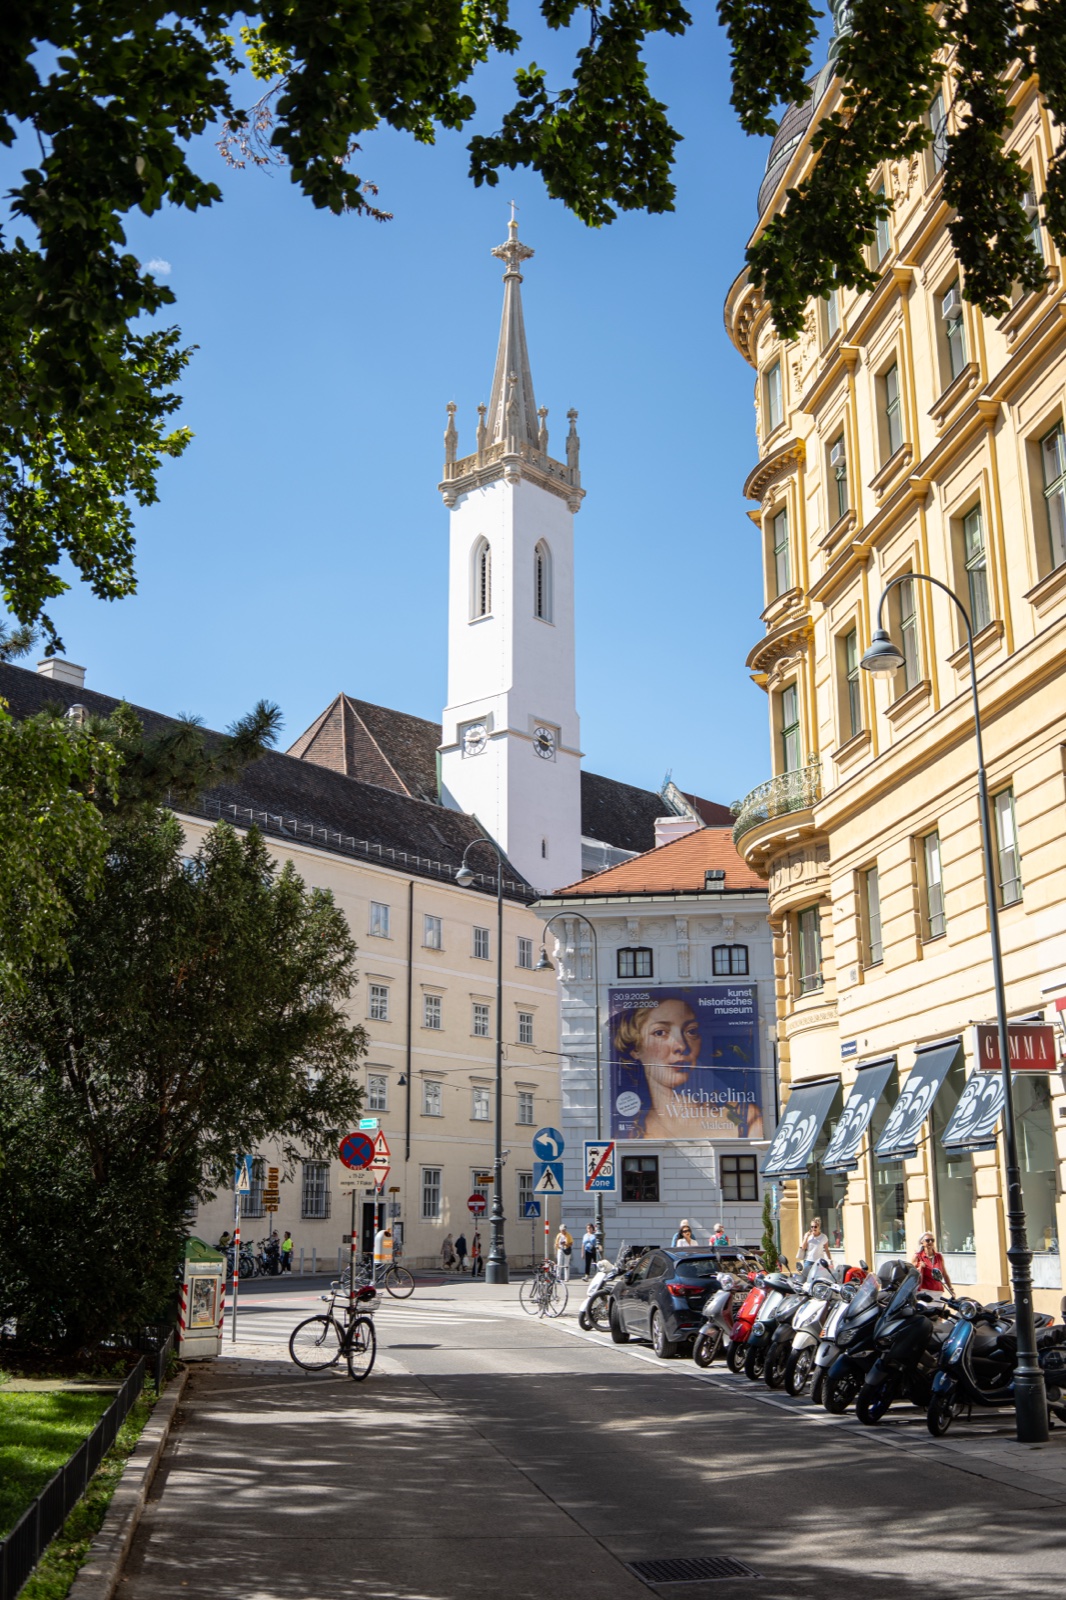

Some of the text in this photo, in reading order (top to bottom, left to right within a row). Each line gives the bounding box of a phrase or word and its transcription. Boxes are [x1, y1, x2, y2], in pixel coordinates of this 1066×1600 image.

[613, 993, 650, 1001] 30.9.2025
[727, 988, 753, 997] kunst
[698, 997, 752, 1007] historisches
[714, 1007, 753, 1015] museum
[672, 1088, 756, 1104] Michaelina
[701, 1120, 736, 1131] Malerin
[602, 1166, 611, 1175] 20
[590, 1179, 610, 1187] Zone
